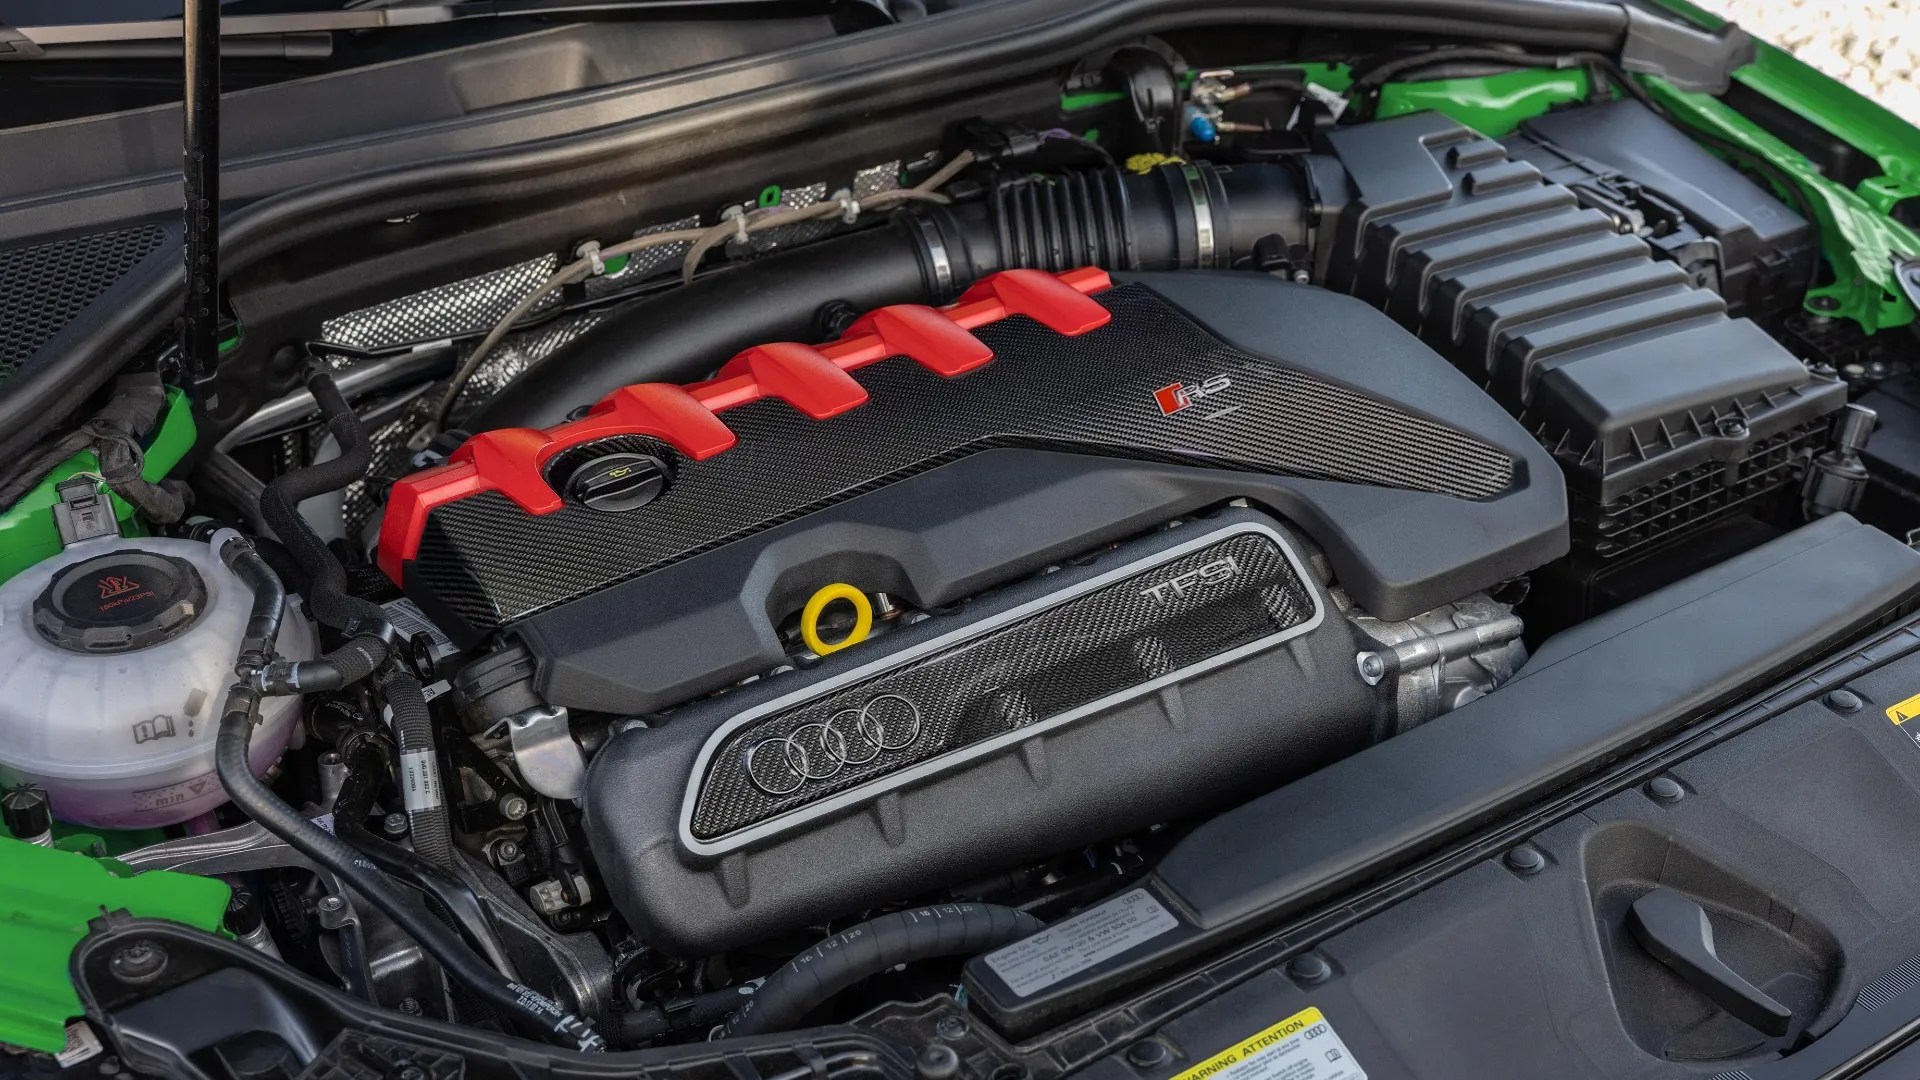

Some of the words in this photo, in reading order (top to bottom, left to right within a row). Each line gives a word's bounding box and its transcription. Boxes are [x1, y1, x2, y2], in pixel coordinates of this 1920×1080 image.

[1140, 556, 1242, 605] TFSI
[156, 793, 185, 807] min
[849, 929, 862, 939] 20
[1243, 1019, 1304, 1057] ATTENTION
